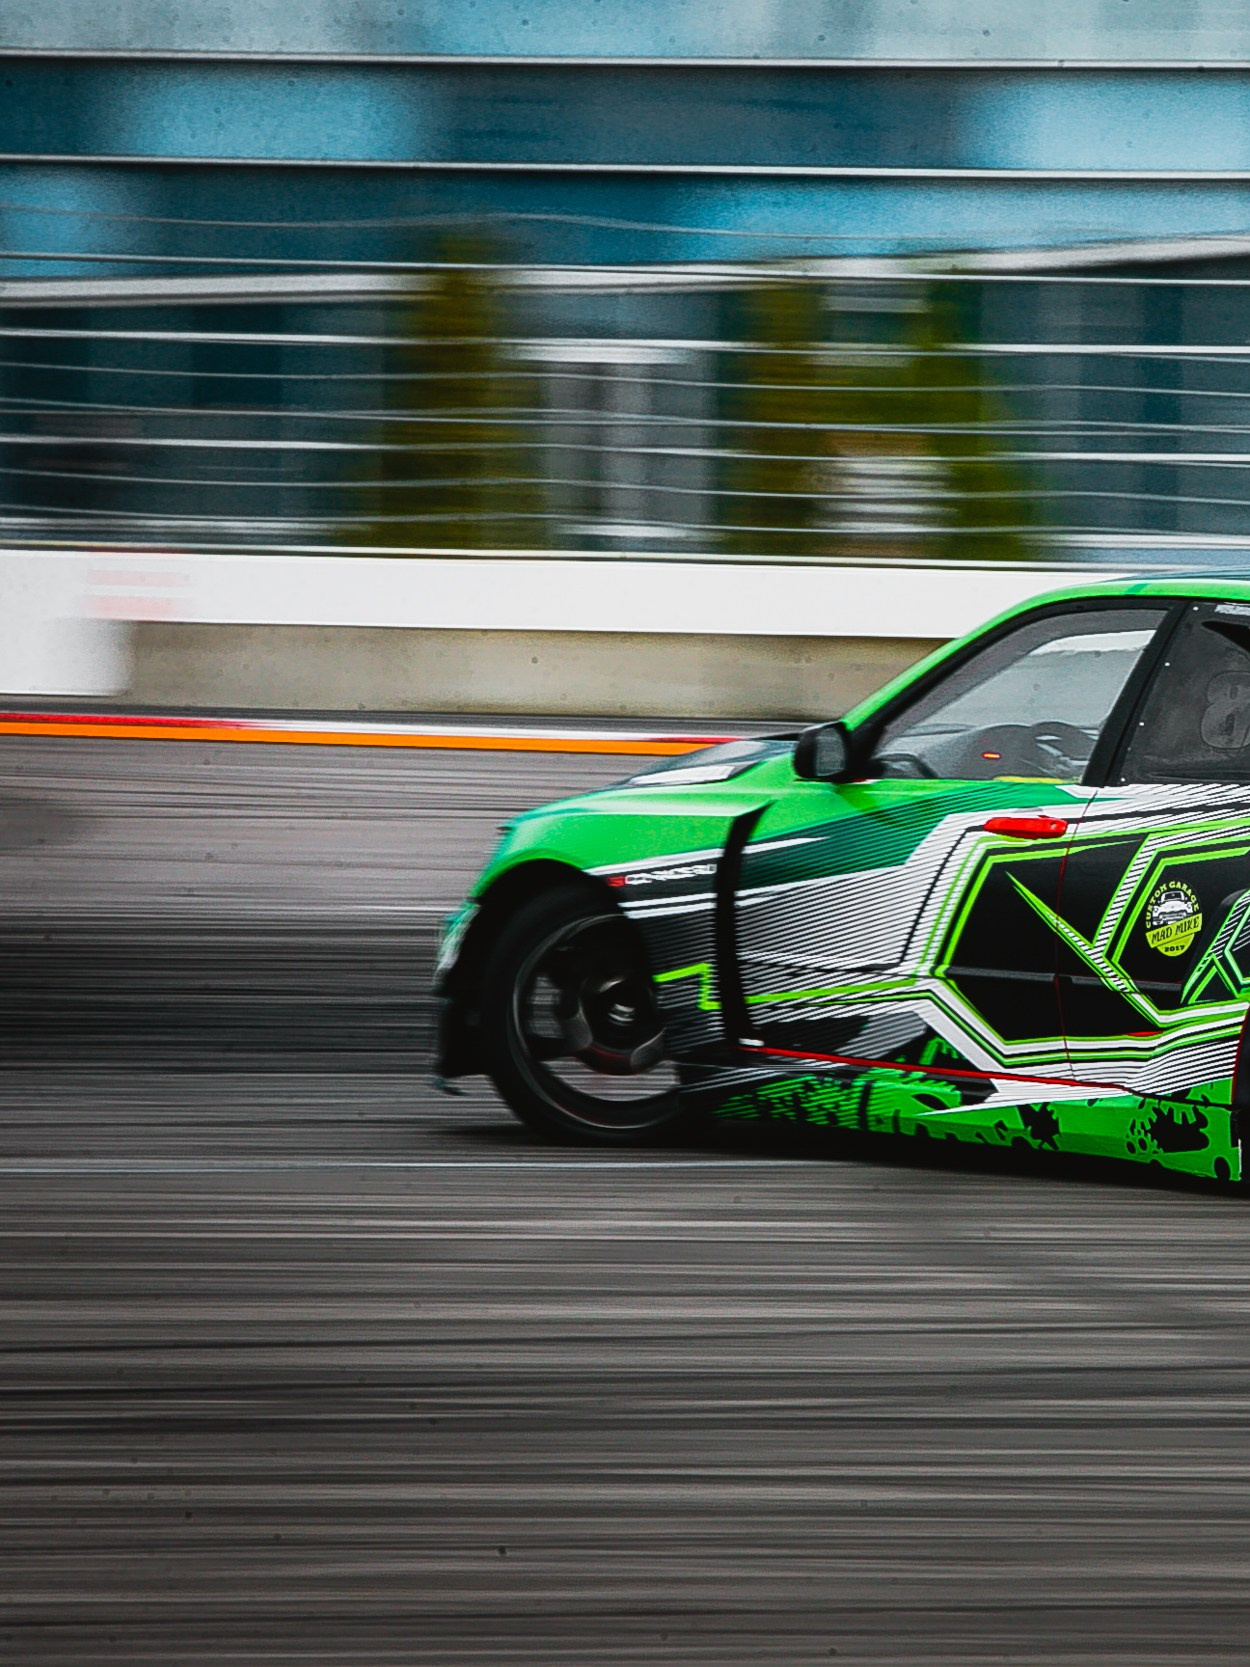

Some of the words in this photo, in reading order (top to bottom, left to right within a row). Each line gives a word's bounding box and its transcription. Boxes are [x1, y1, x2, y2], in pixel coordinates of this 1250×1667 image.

[1145, 883, 1167, 929] CUSTOM
[1168, 881, 1200, 912] GARAGE
[1151, 926, 1173, 945] MAD
[1175, 915, 1200, 936] MIKE
[1163, 944, 1186, 953] 2017
